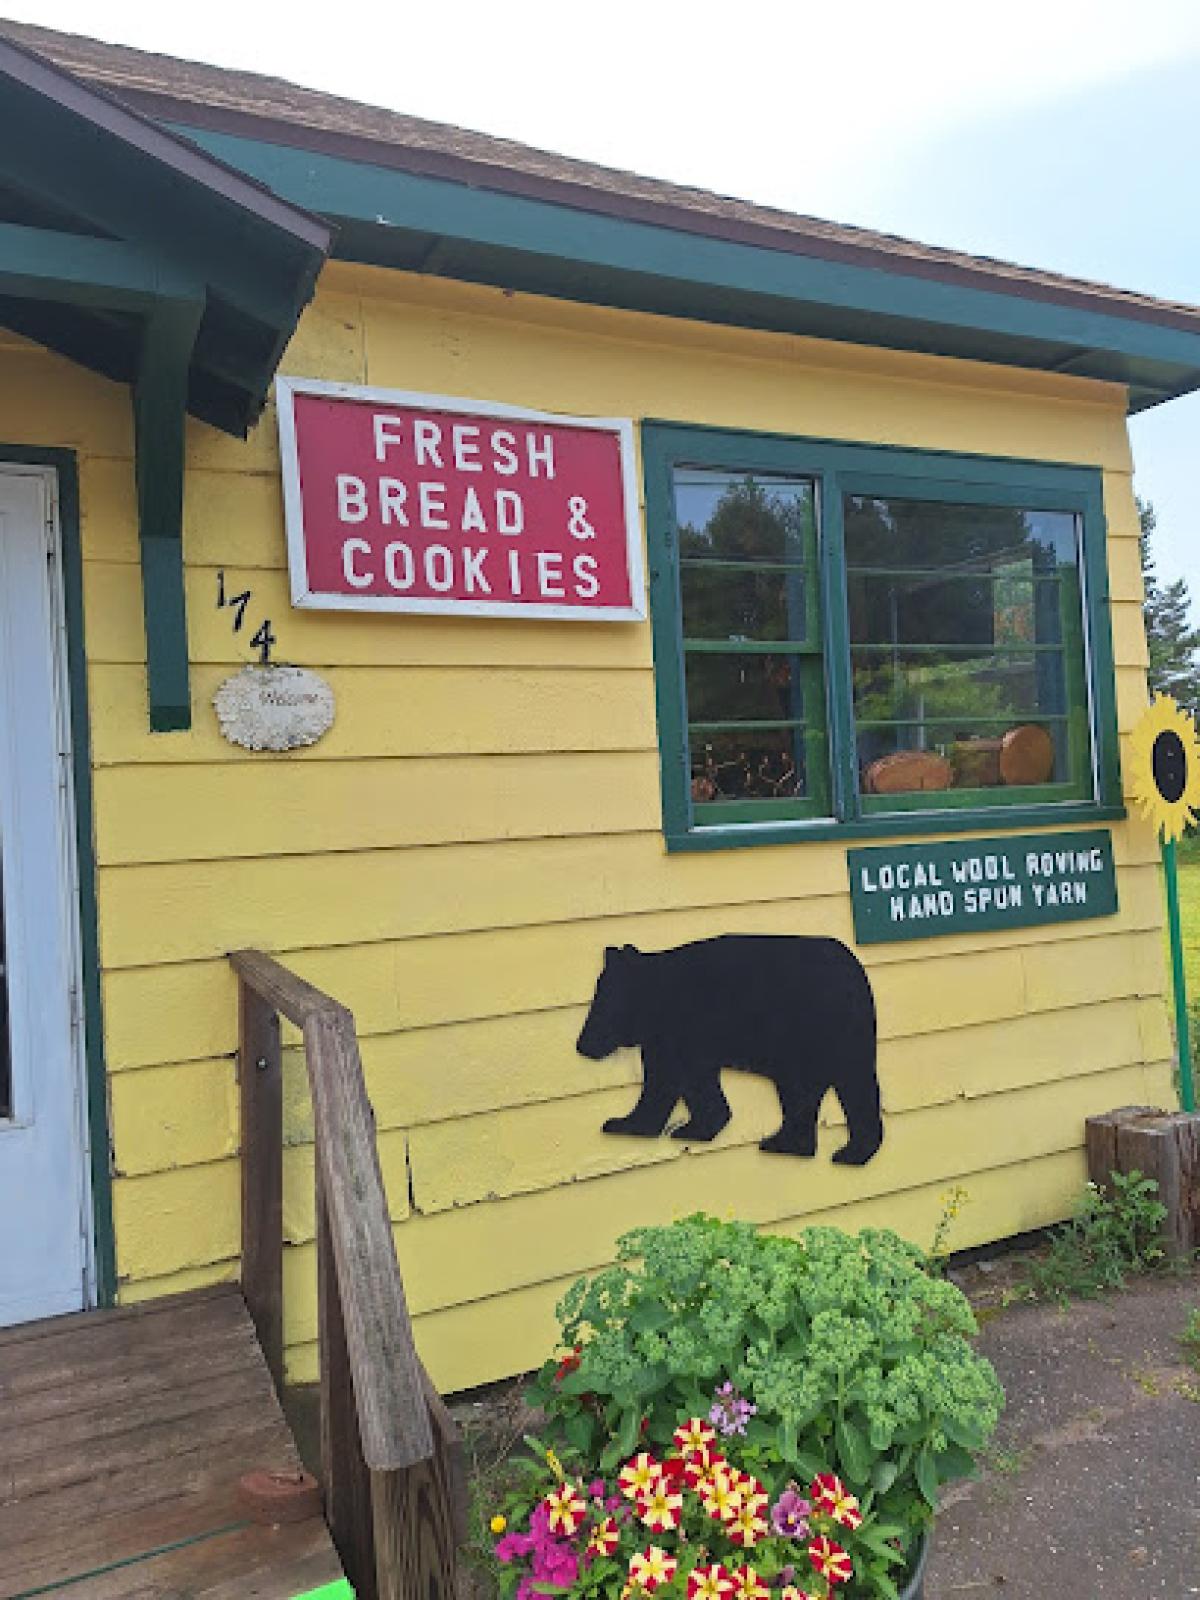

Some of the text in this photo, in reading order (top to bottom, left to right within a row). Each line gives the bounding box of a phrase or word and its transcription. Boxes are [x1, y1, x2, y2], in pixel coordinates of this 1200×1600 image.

[372, 414, 556, 480] FRESH
[336, 473, 596, 540] BREAD &
[341, 537, 601, 598] COOKIES
[217, 569, 276, 664] 174
[861, 849, 1104, 892] LOCAL WOOL ROVING
[890, 881, 1087, 921] HAND SPUN YARN
